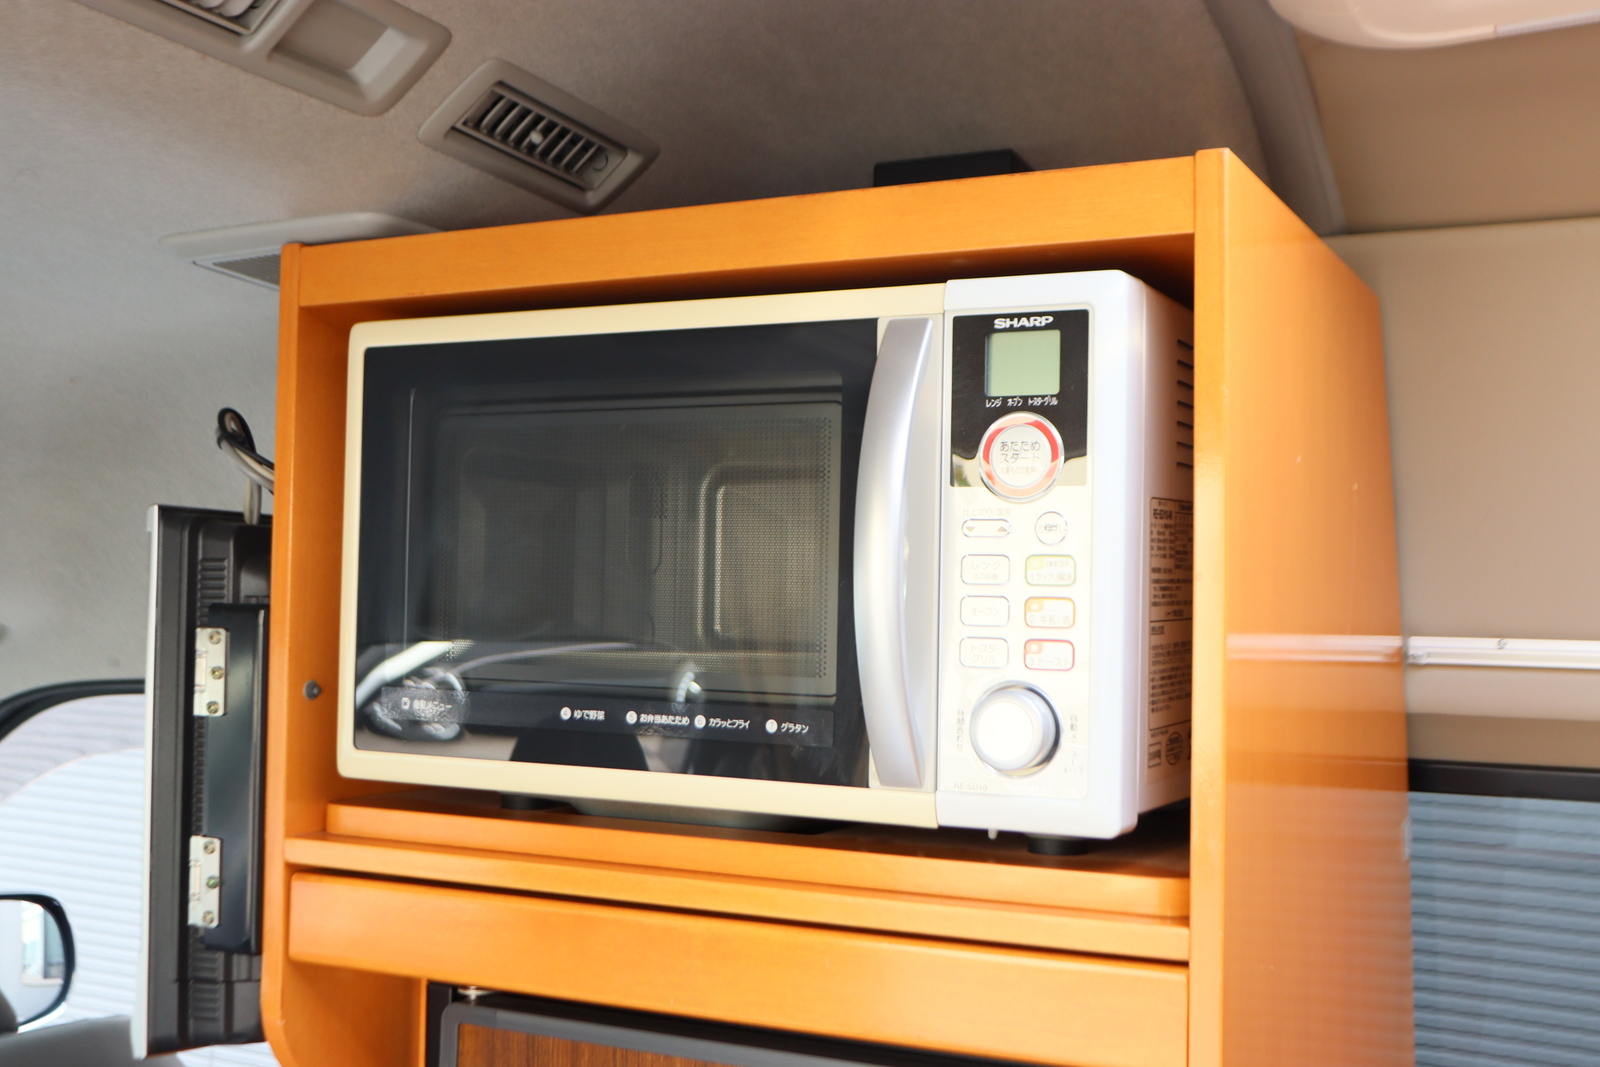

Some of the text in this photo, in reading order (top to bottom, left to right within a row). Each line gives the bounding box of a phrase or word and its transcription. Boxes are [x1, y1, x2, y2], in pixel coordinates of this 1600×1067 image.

[993, 315, 1054, 329] SHARP
[985, 397, 1003, 408] レンジ
[999, 440, 1041, 452] あたため
[1000, 453, 1041, 464] スタート
[971, 560, 1001, 571] レンジ
[970, 644, 1000, 654] トースター
[971, 654, 997, 664] グリル
[1038, 656, 1071, 666] トースト
[573, 709, 606, 720] ゆで野菜
[639, 713, 690, 726] お弁当あたため
[709, 717, 751, 729] カラッとフライ
[781, 722, 809, 734] グラタン
